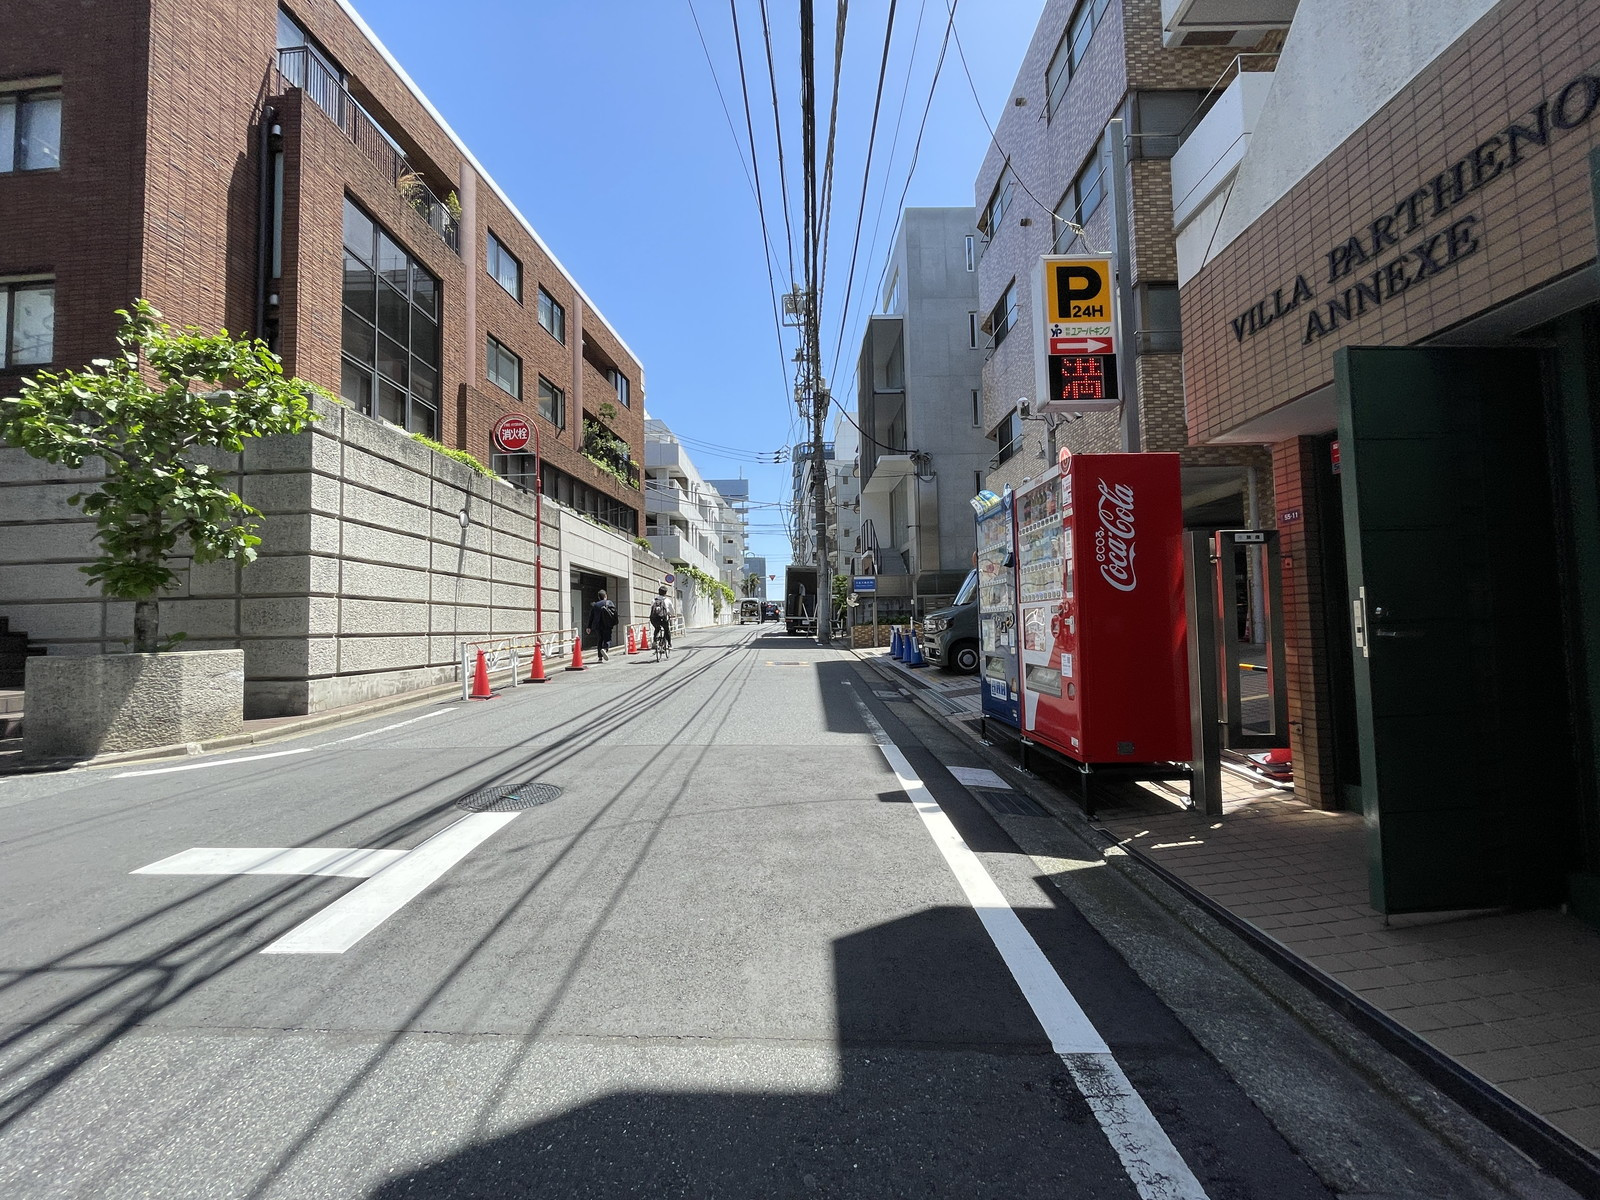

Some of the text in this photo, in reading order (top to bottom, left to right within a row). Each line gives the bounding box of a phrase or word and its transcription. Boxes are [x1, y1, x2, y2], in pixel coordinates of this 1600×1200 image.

[1229, 75, 1600, 343] VILLA PARTHENO
[1056, 266, 1102, 318] P
[1302, 215, 1481, 345] ANNEXE
[1072, 305, 1104, 318] 24H
[1062, 358, 1103, 398] 満
[502, 428, 527, 441] 消火栓
[1097, 477, 1136, 592] Coca-Cola
